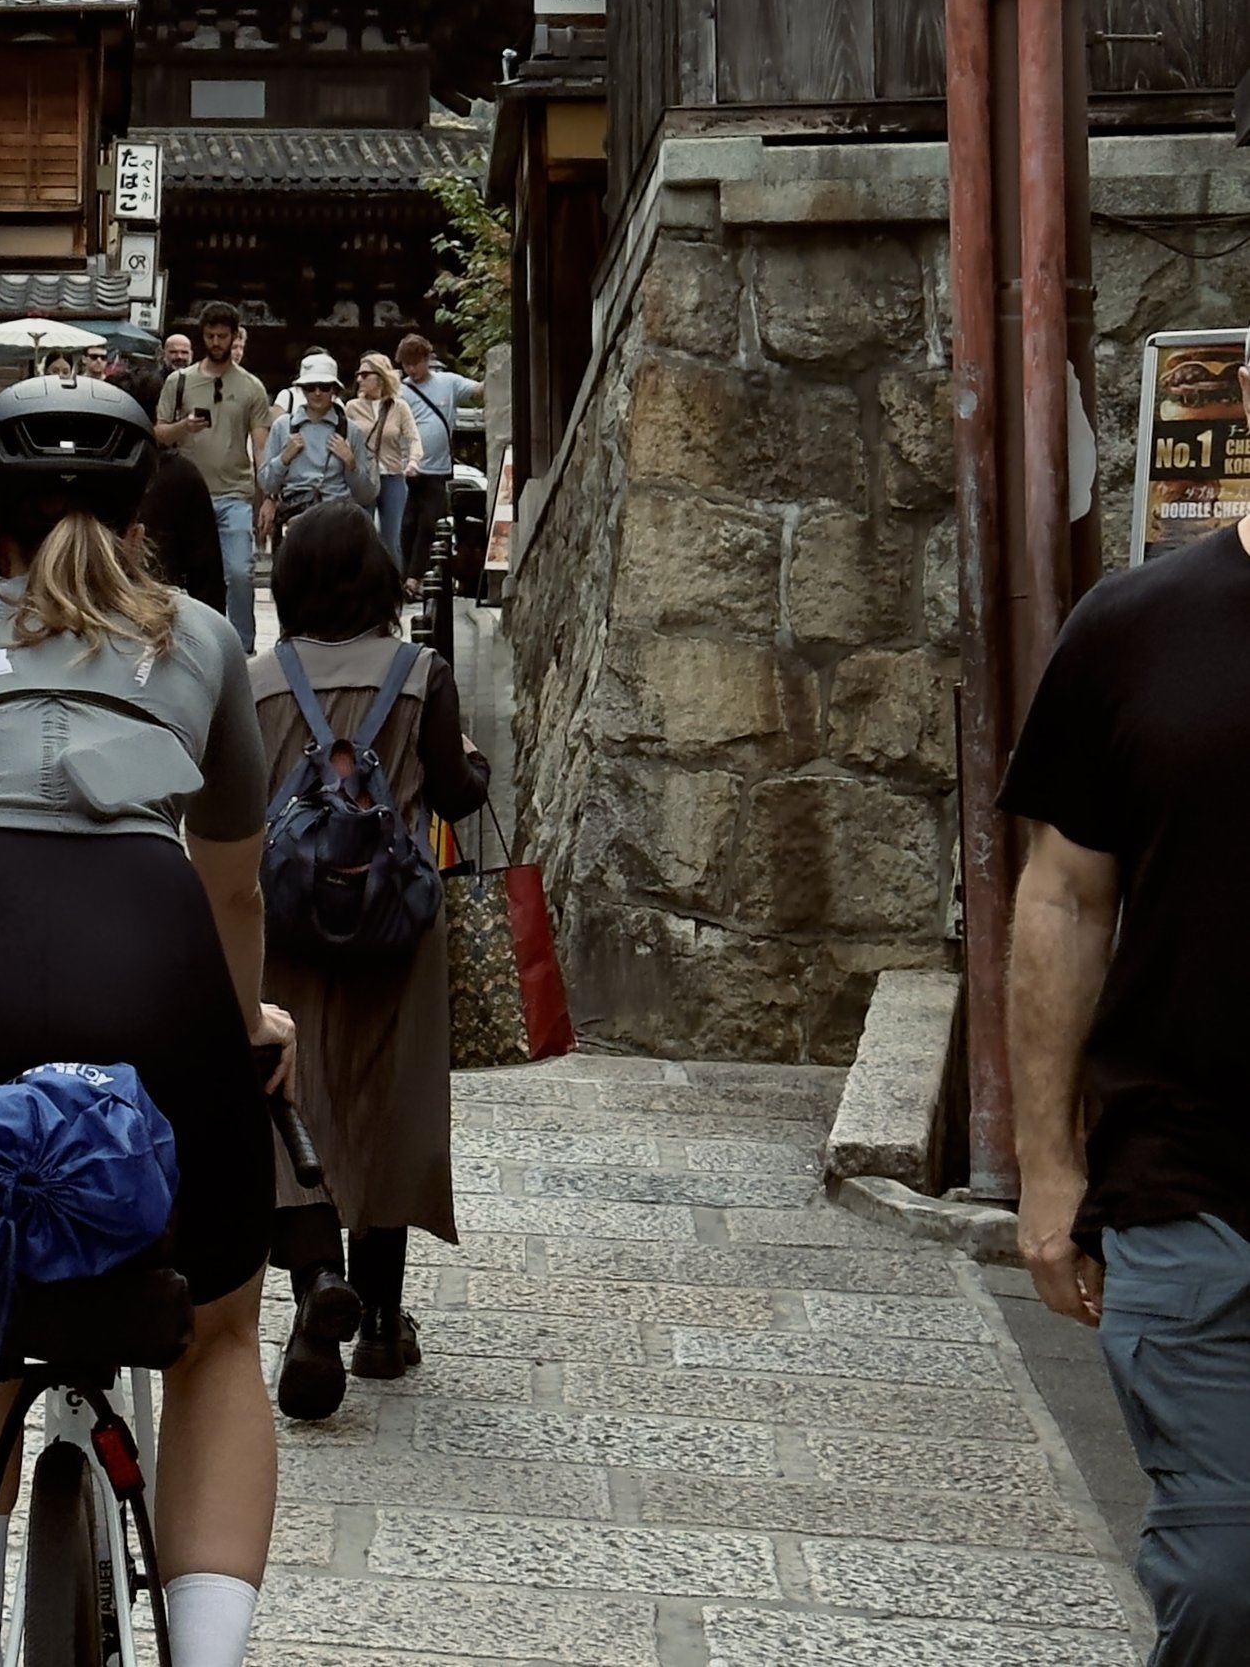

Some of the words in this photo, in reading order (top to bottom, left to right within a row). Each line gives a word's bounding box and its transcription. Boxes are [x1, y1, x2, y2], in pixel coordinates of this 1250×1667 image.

[120, 148, 138, 211] たばこ
[1155, 429, 1213, 468] No.1
[1160, 501, 1211, 519] DOUBLE
